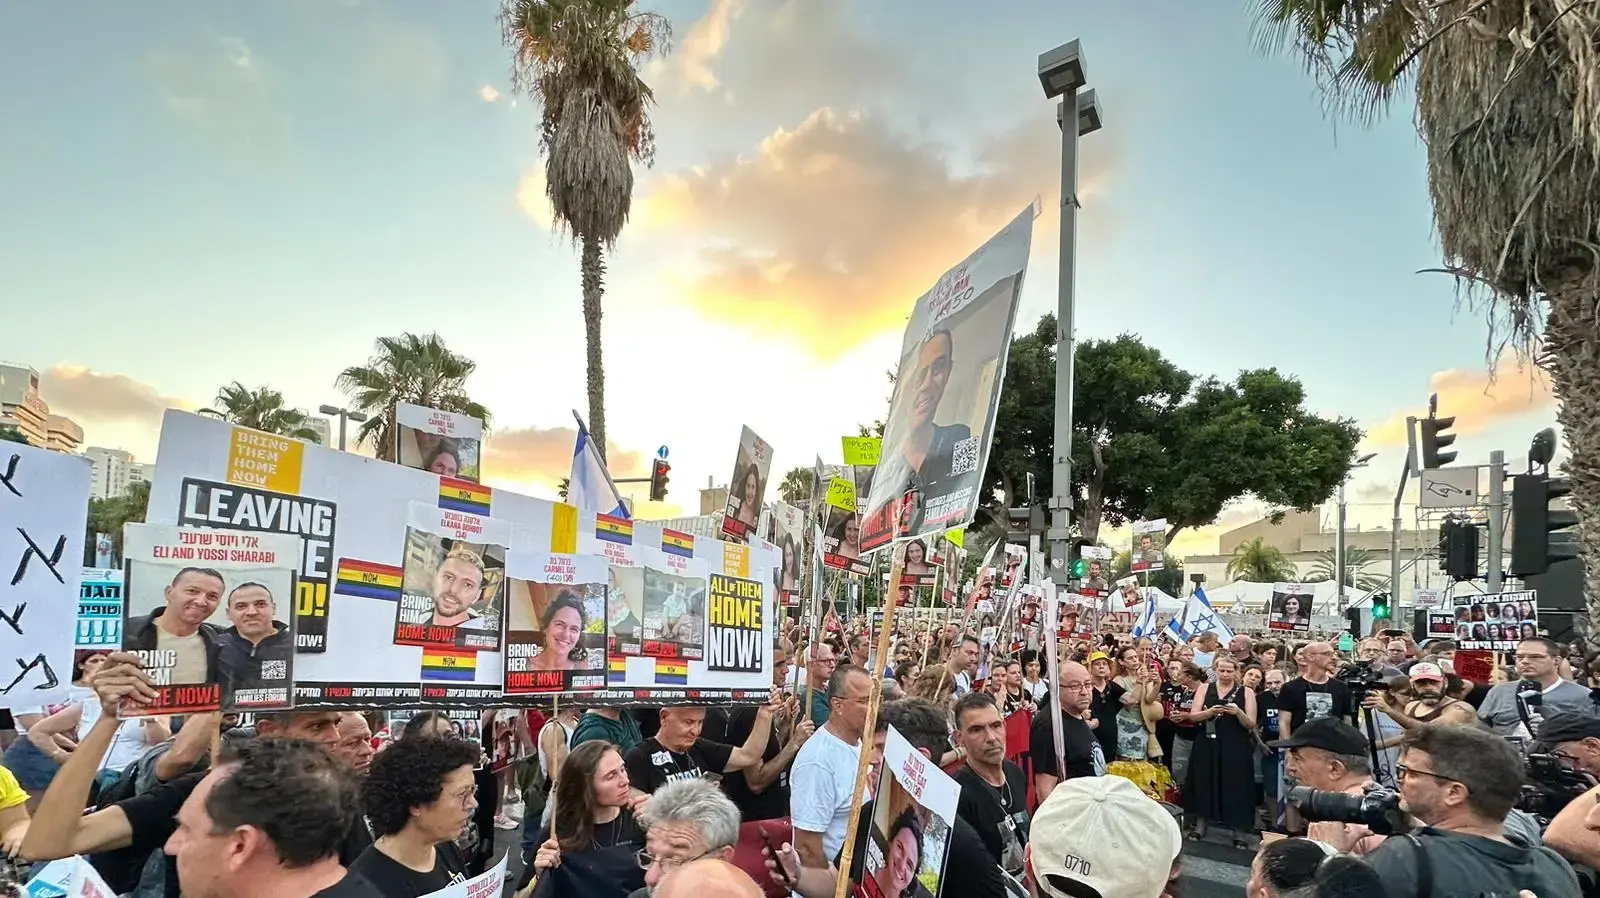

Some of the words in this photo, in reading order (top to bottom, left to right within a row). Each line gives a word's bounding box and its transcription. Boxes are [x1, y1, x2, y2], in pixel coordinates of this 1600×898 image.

[953, 286, 974, 309] 50
[237, 431, 288, 452] BRING
[236, 444, 278, 462] THEM
[234, 458, 277, 474] HOME
[232, 470, 267, 484] NOW
[459, 490, 472, 500] NOW
[184, 484, 333, 537] LEAVING
[441, 519, 461, 530] ELKANA
[462, 522, 483, 534] BOHBOT
[179, 532, 212, 545] שרעבי
[215, 534, 238, 546] ויוסי
[241, 536, 258, 548] אלי
[154, 546, 169, 558] ELI
[172, 546, 194, 559] AND
[197, 548, 228, 561] YOSSI
[231, 550, 275, 564] SHARABI
[544, 565, 566, 574] CARMEL
[362, 572, 378, 583] NOW
[711, 577, 731, 594] ALL
[736, 580, 761, 599] THEM
[401, 594, 432, 610] BRING
[400, 608, 420, 623] HIM
[710, 594, 762, 629] HOME
[398, 624, 426, 640] HOME
[428, 627, 456, 642] NOW!
[508, 644, 538, 658] BRING
[708, 626, 762, 669] NOW!
[442, 658, 456, 666] NOW
[508, 658, 527, 672] HER
[508, 672, 534, 687] HOME
[537, 670, 564, 686] NOW!
[176, 684, 220, 704] NOW!
[235, 694, 264, 704] FAMILIES
[265, 692, 287, 702] FORUM
[352, 688, 374, 698] הביתה
[376, 688, 394, 697] אותם
[395, 688, 420, 698] מחזירים
[446, 688, 466, 698] הביתה
[1064, 854, 1091, 876] 0710
